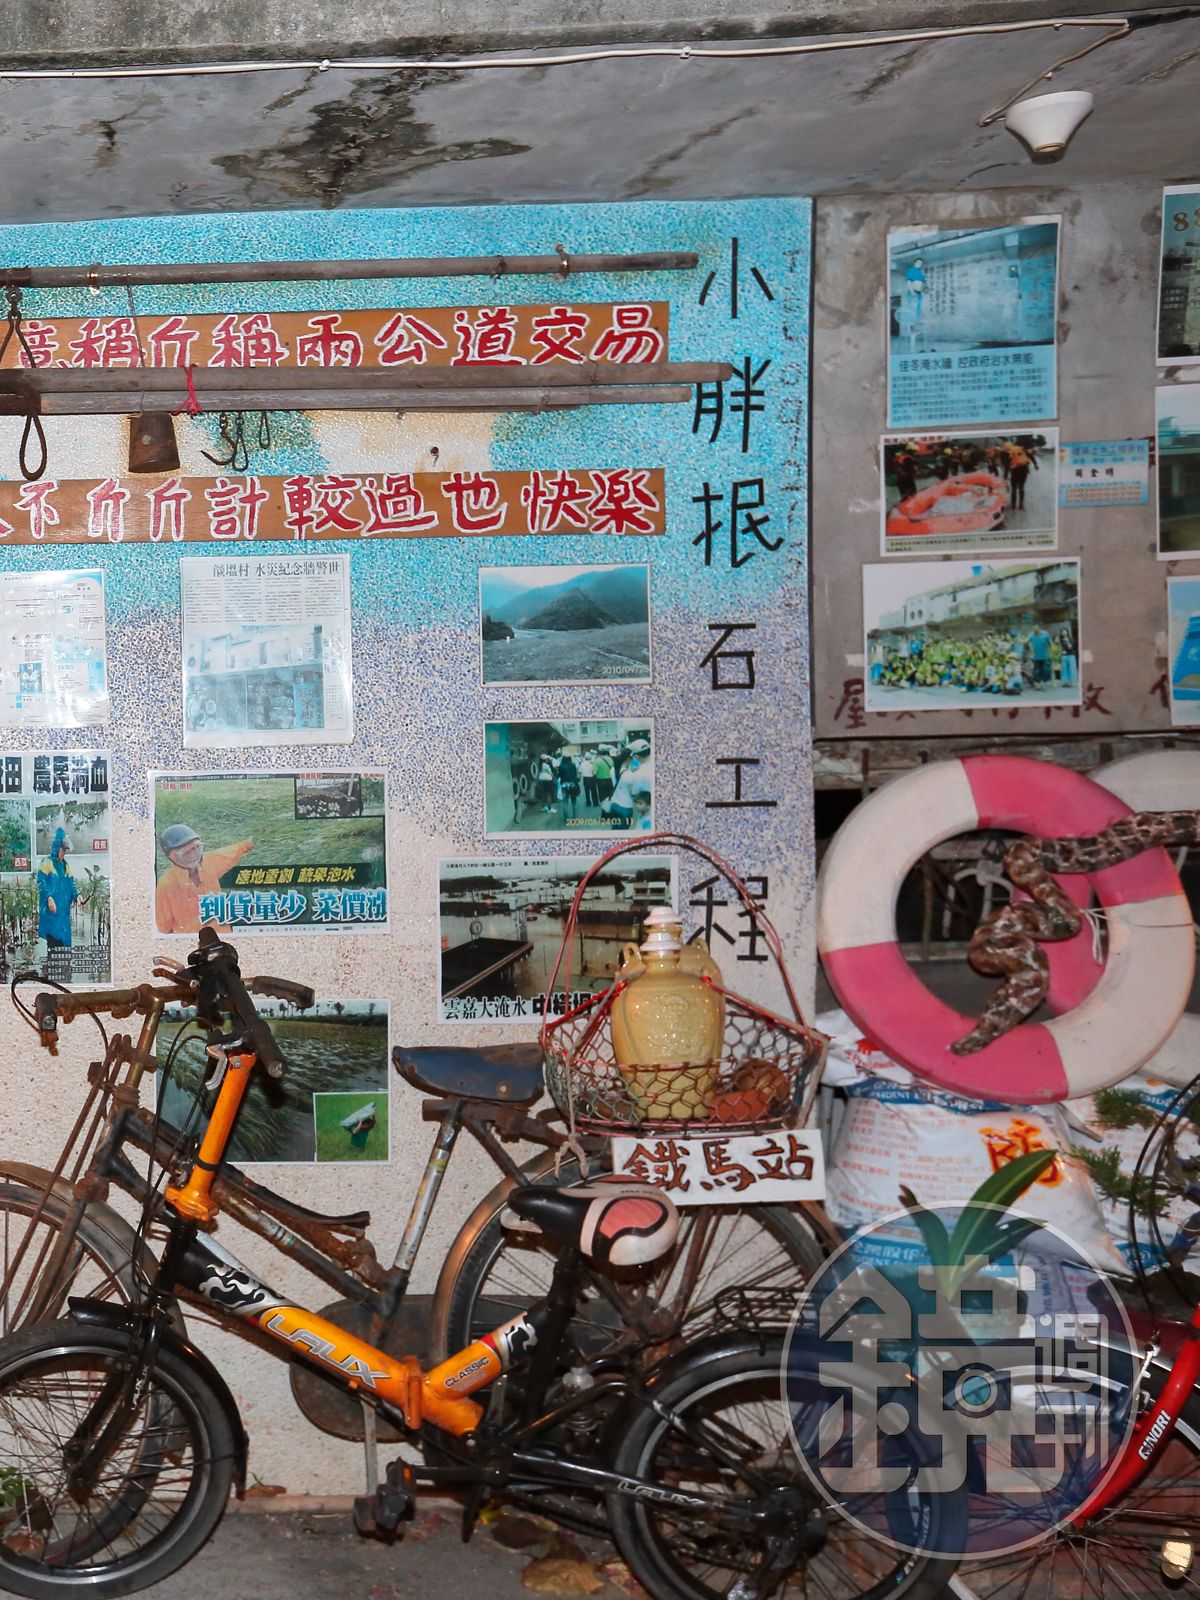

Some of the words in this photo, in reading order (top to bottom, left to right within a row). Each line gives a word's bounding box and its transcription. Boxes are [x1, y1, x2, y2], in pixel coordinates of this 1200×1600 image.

[198, 889, 308, 925] 到貨量少
[623, 1134, 814, 1192] 鐵馬站
[444, 1355, 491, 1388] CLASSIC
